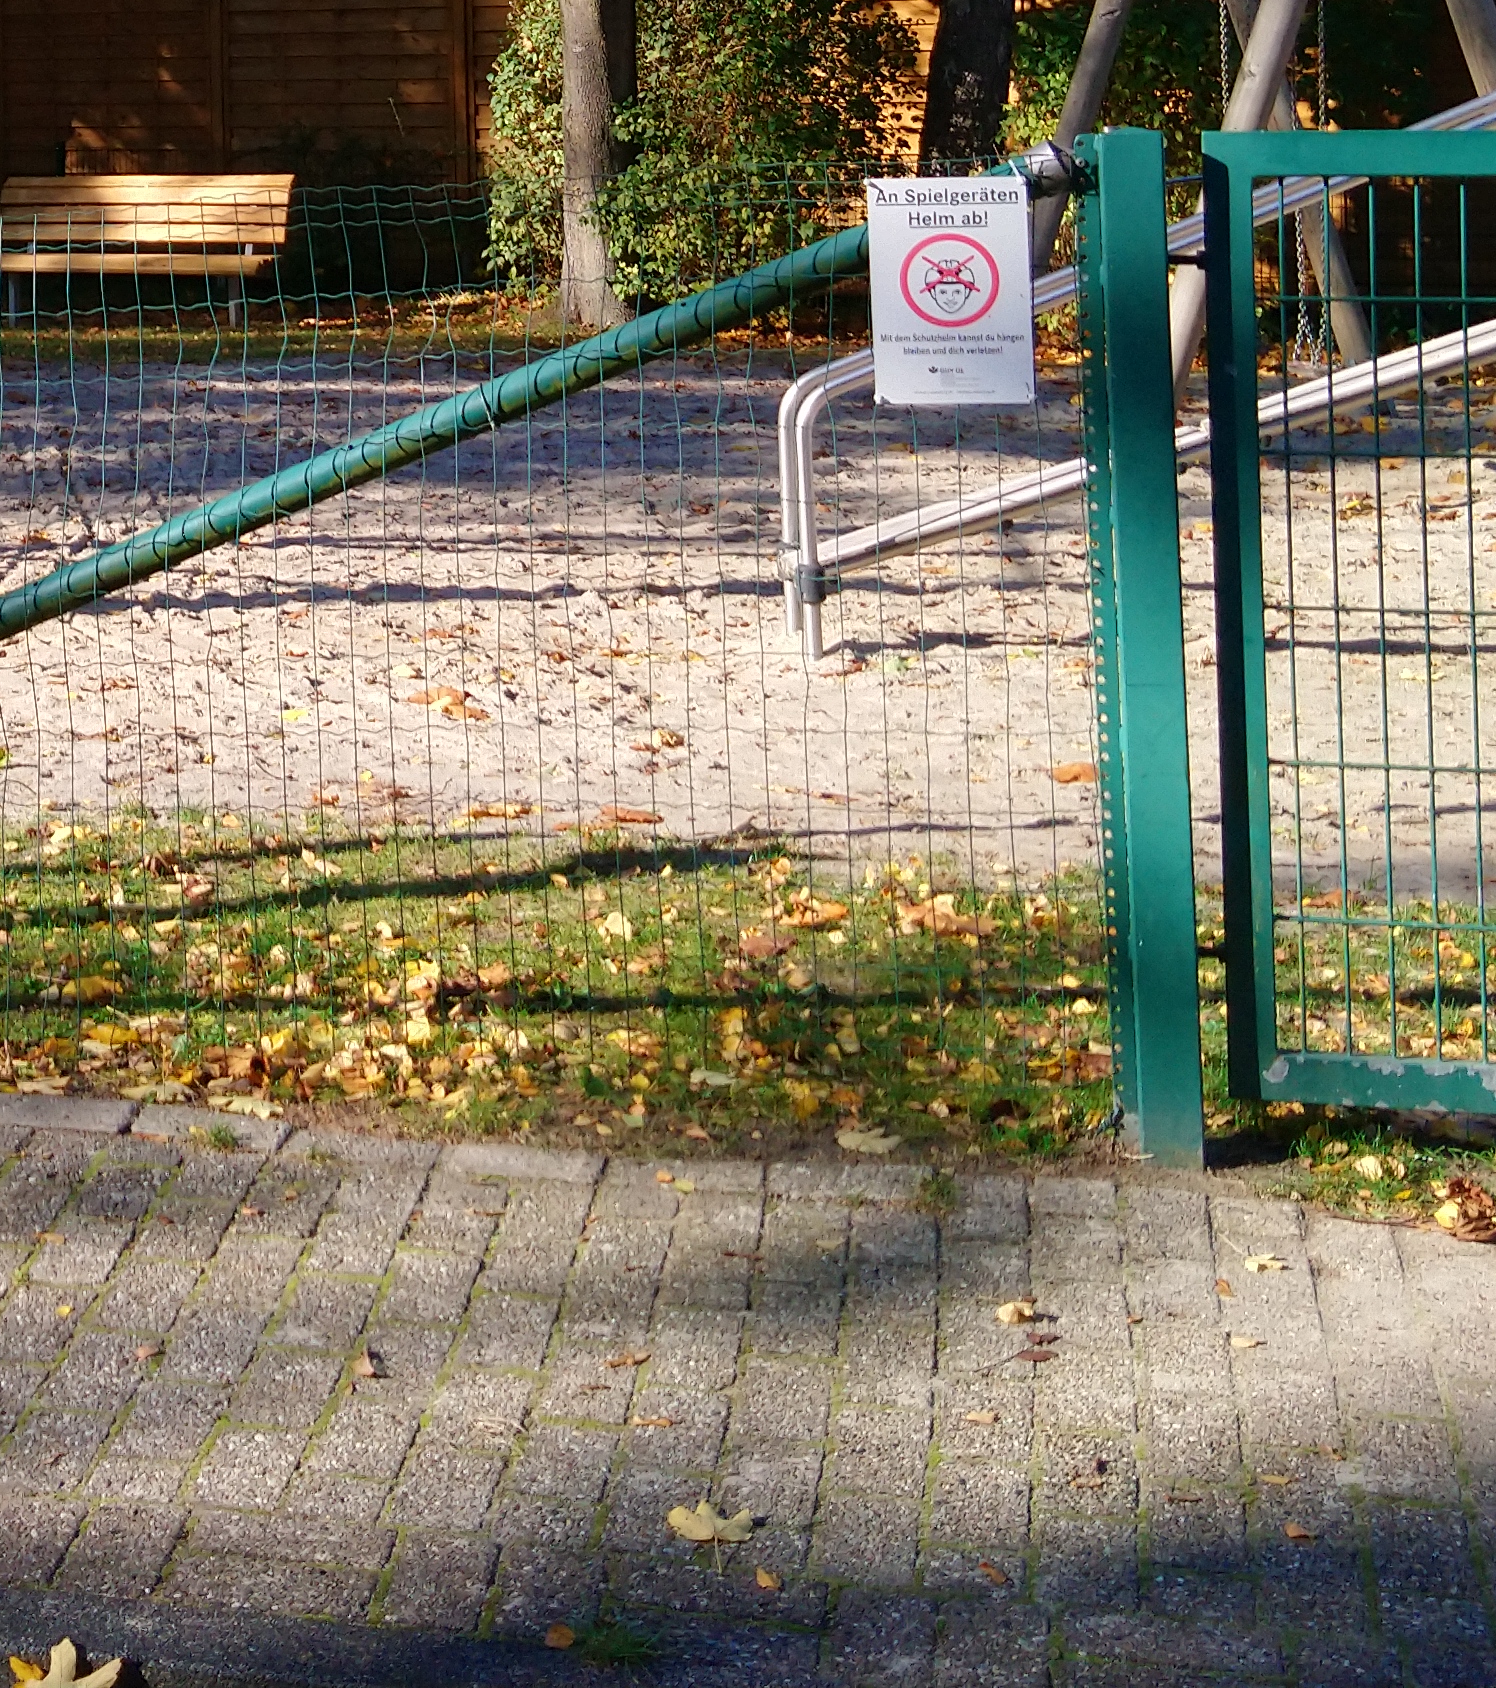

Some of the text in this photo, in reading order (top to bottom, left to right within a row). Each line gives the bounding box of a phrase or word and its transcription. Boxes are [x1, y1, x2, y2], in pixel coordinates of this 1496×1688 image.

[875, 187, 1019, 206] An Spielgeräten
[908, 210, 989, 226] Helm ab!
[880, 333, 893, 343] Mit
[894, 333, 911, 343] dem
[912, 332, 956, 343] Schutzhelm
[957, 333, 984, 342] kannst
[985, 333, 995, 342] du
[903, 346, 931, 355] bleiben
[932, 346, 947, 355] und
[948, 346, 965, 355] dich
